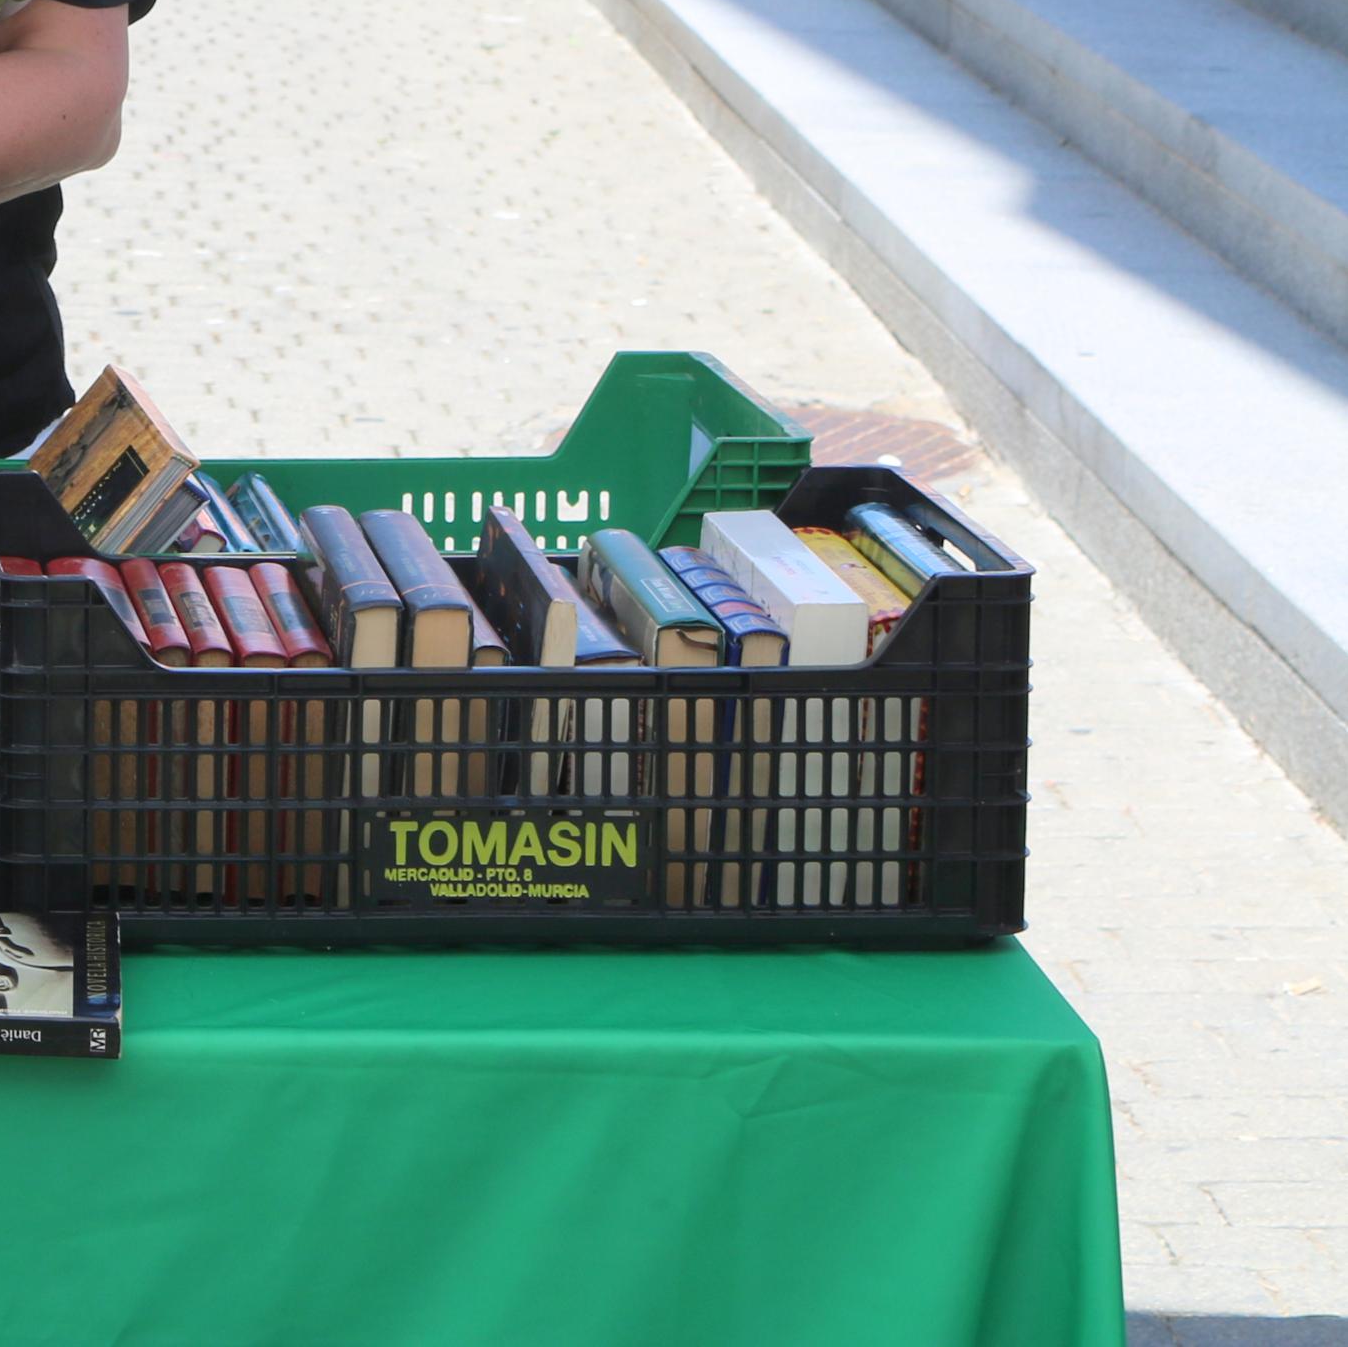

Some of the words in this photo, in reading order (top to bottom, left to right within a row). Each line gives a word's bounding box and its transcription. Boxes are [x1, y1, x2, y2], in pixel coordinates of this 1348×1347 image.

[389, 821, 637, 868] TOMASIN
[384, 868, 474, 882] MERCAOLID
[486, 868, 521, 882] PTO.
[523, 869, 533, 881] 8
[430, 883, 590, 899] VALLADOLID-MURCIA
[86, 920, 107, 962] HISTORICA
[86, 962, 107, 1000] NOVELA
